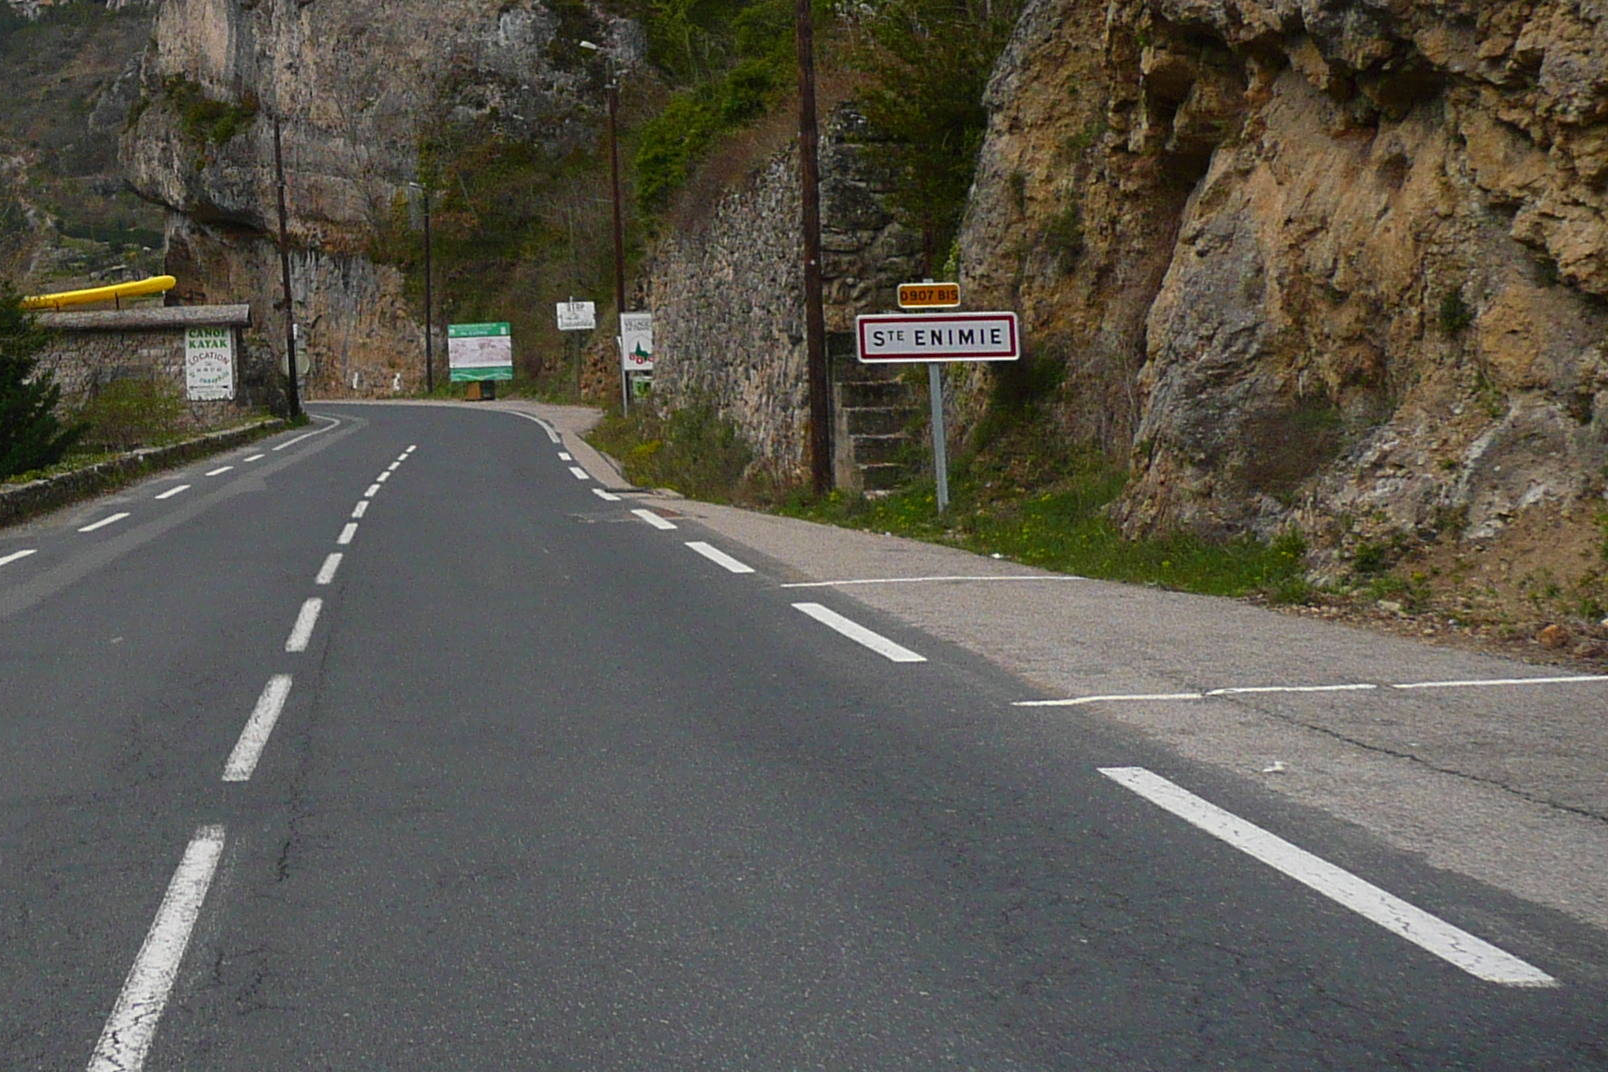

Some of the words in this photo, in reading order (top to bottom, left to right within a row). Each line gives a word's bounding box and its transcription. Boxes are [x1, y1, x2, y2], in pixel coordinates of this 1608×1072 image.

[900, 290, 933, 302] D907
[938, 289, 959, 301] BIS
[189, 329, 228, 338] CANOE
[915, 328, 1002, 346] ENIMIE
[189, 339, 228, 349] KAYAK
[188, 352, 230, 365] LOCATION
